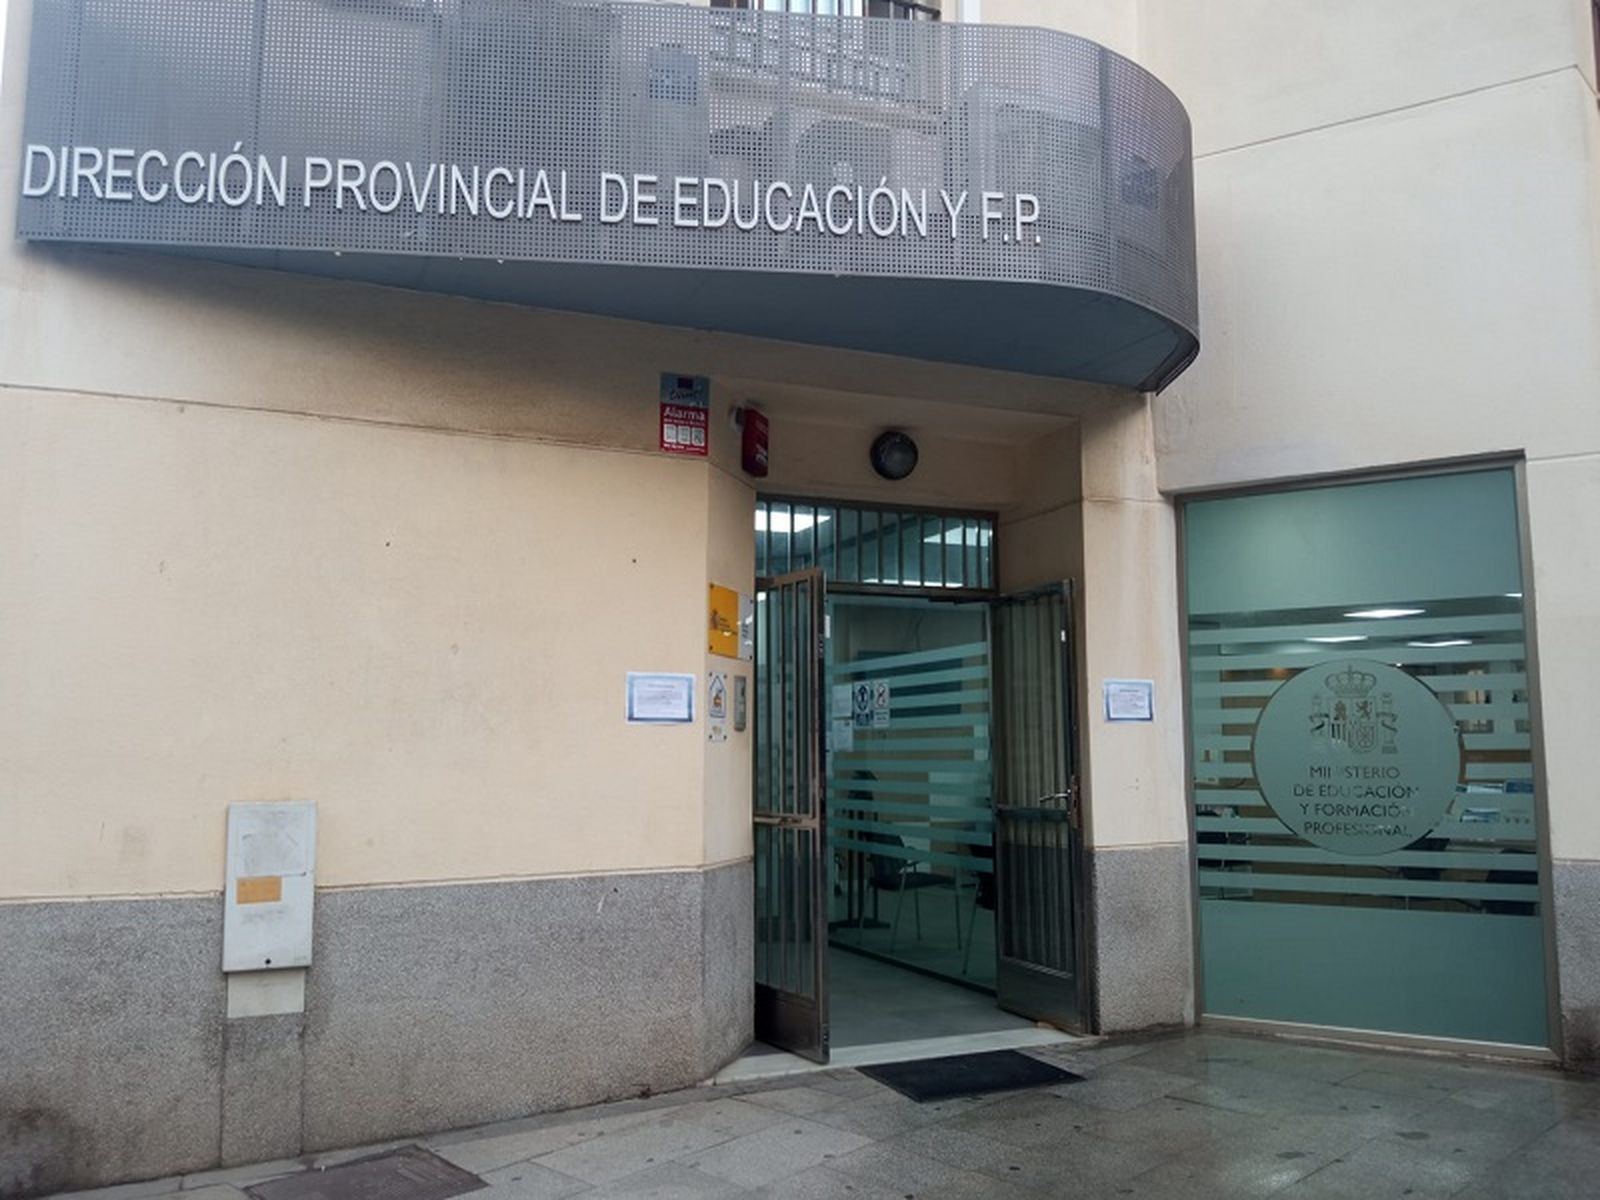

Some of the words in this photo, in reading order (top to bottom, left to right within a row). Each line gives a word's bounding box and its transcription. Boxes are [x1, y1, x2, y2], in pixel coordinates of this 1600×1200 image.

[22, 141, 288, 208] DIRECCIÓN
[303, 156, 583, 222] PROVINCIAL
[600, 171, 659, 225] DE
[673, 176, 928, 240] EDUCACIÓN
[939, 190, 968, 239] Y
[981, 191, 1042, 245] F.P.
[663, 406, 706, 420] Alarma
[1309, 765, 1400, 779] MISTERIO
[1293, 784, 1314, 798] DE
[1300, 803, 1310, 816] Y
